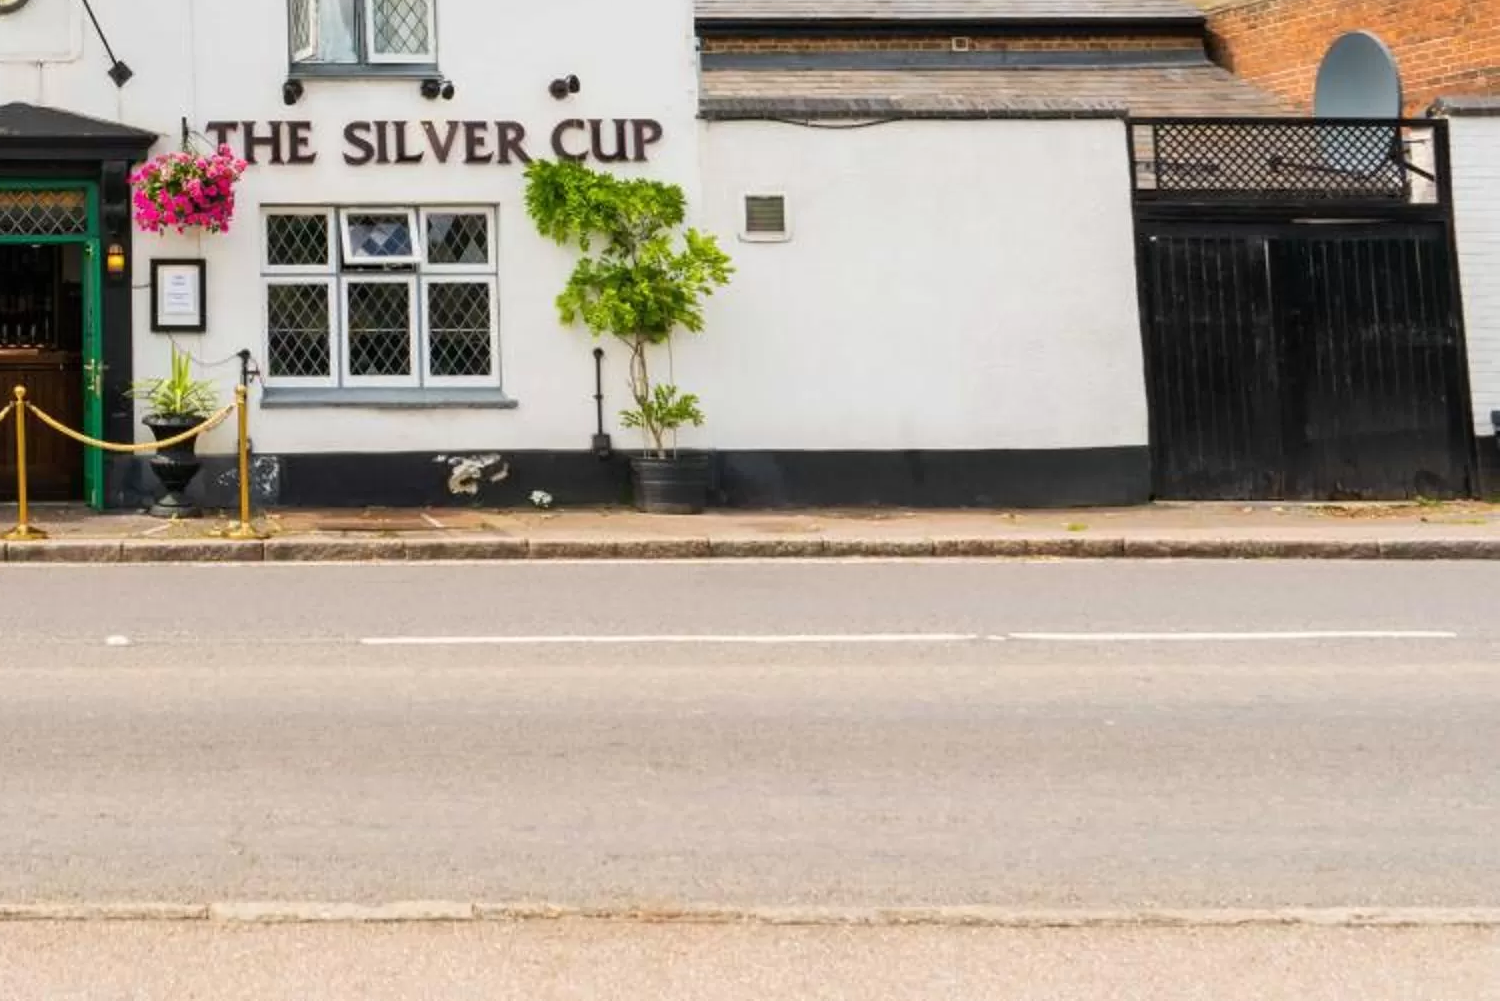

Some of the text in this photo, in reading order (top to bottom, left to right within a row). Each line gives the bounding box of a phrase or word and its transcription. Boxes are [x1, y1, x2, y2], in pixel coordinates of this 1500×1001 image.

[206, 118, 663, 165] THE SILVER CUP
